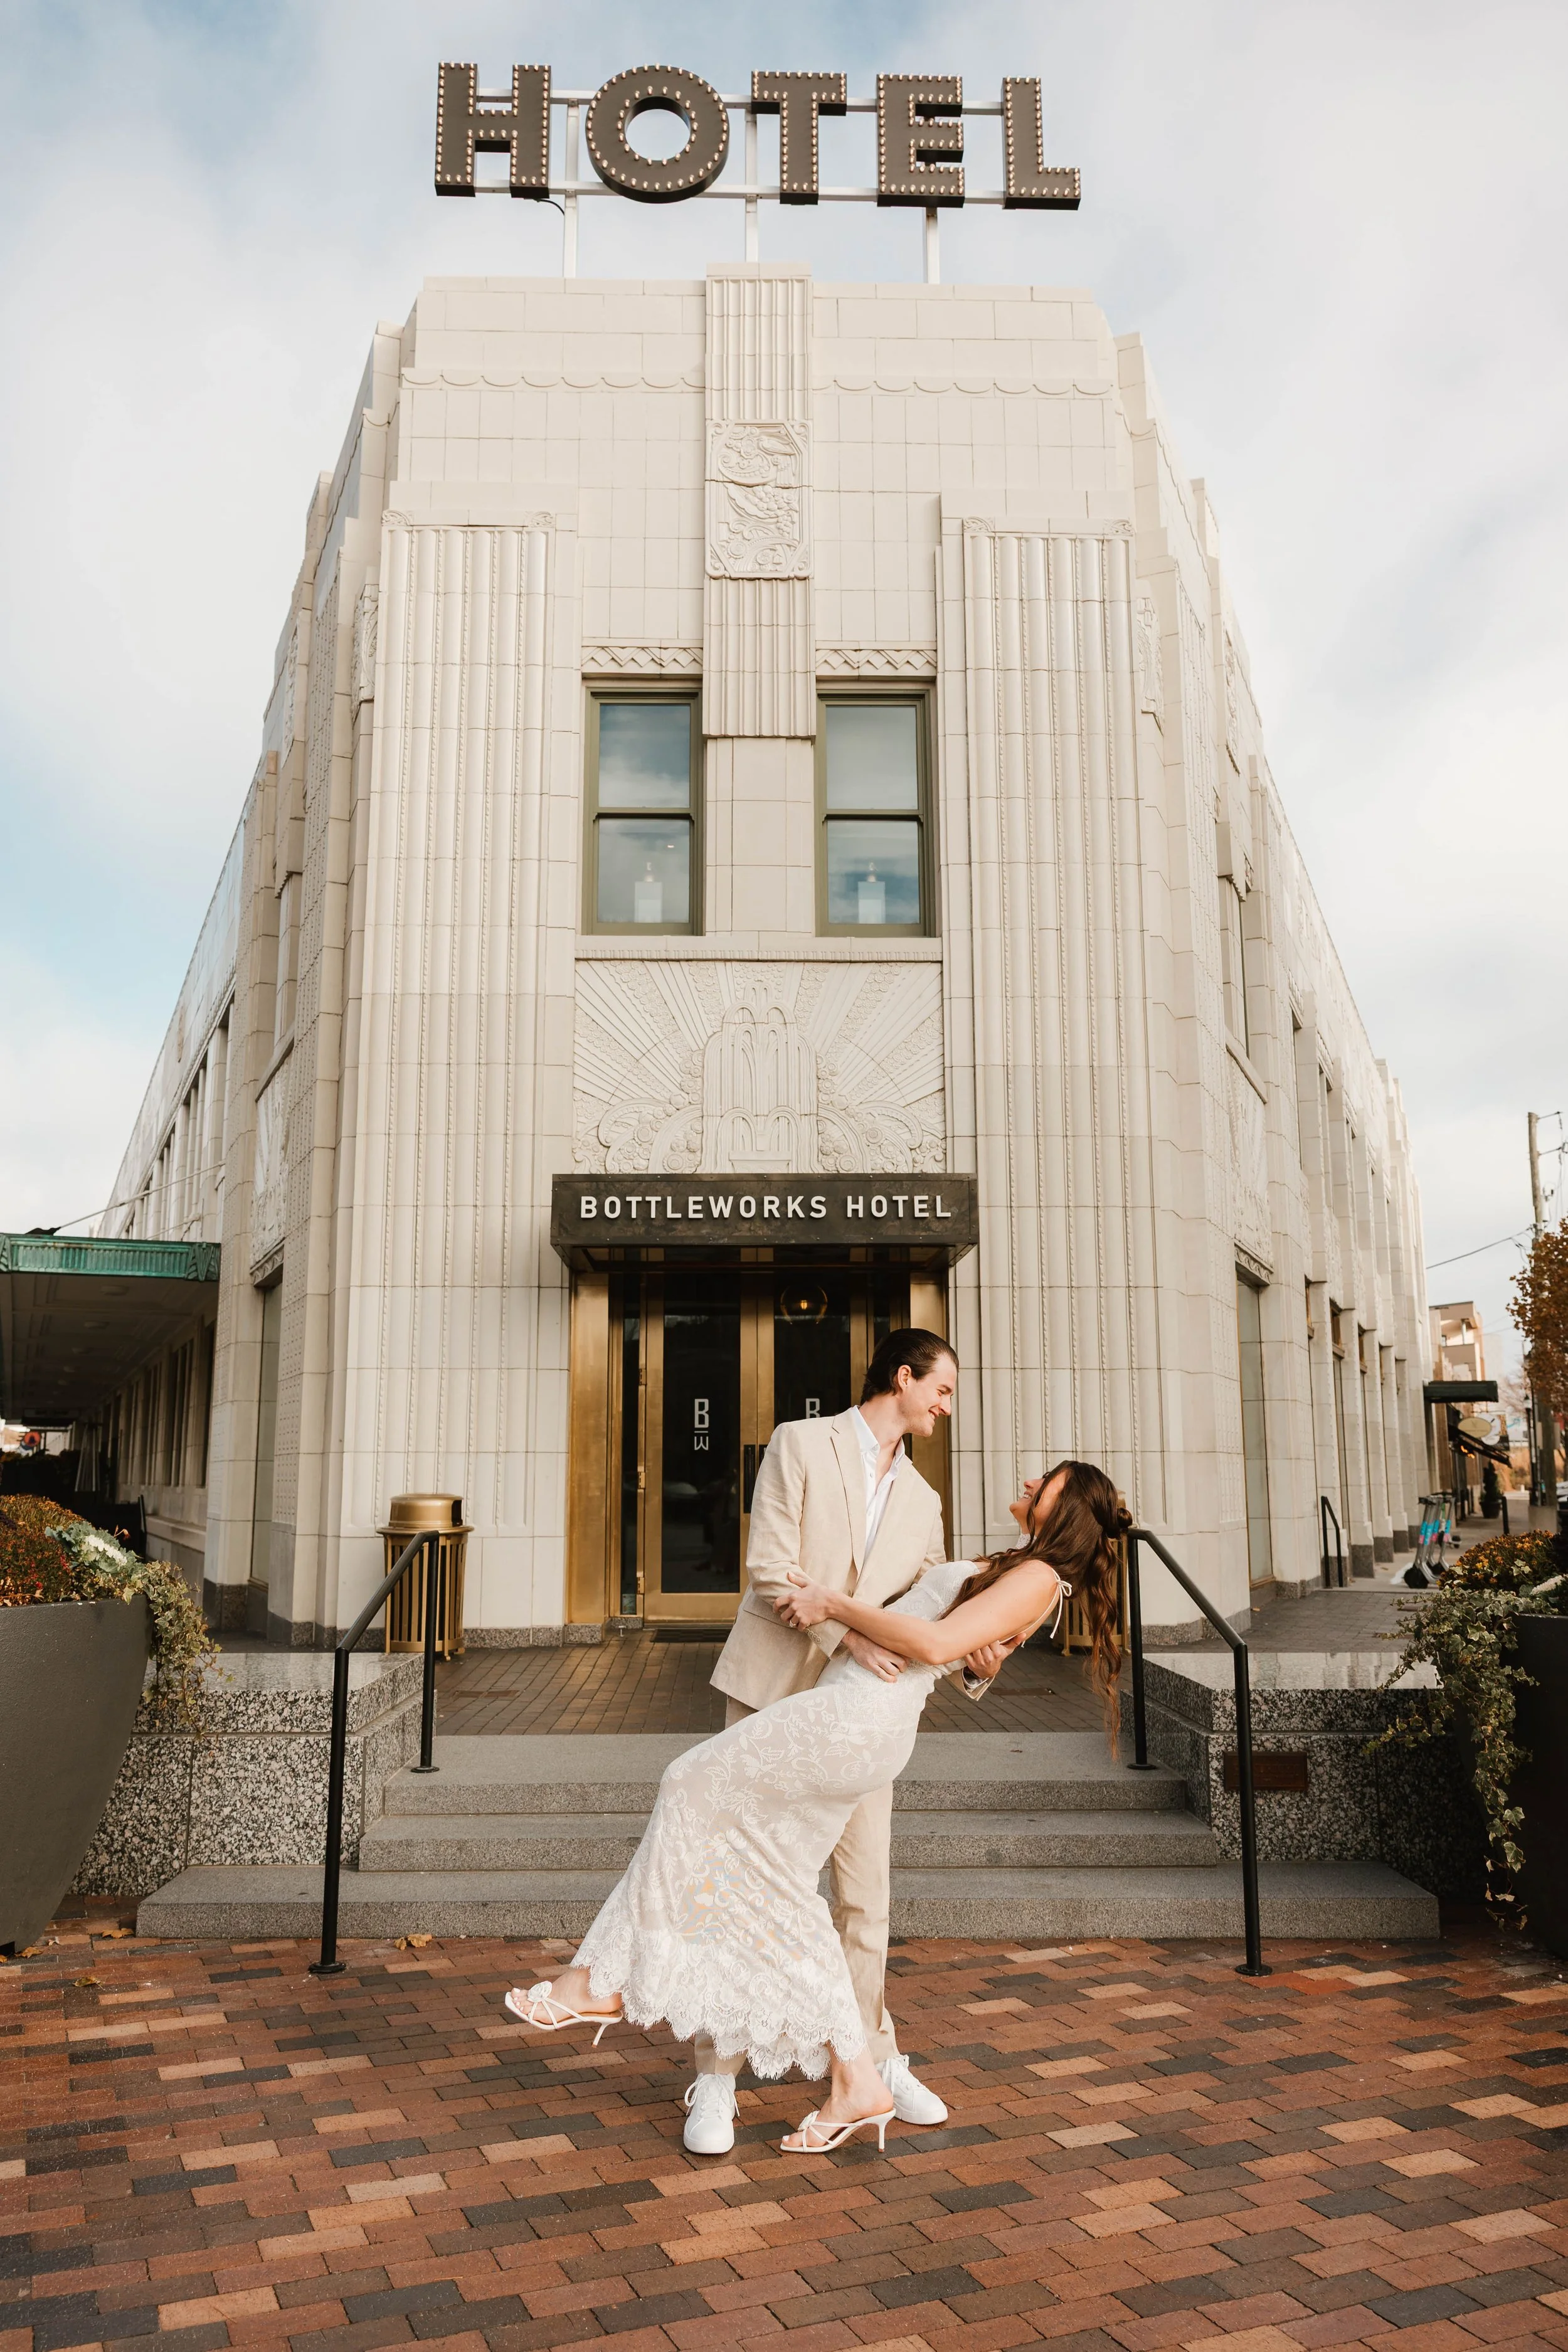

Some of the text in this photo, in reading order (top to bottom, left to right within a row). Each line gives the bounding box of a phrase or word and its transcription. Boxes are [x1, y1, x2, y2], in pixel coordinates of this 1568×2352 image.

[435, 61, 1082, 209] HOTEL
[580, 1194, 952, 1219] BOTTLEWORKS HOTEL
[694, 1398, 709, 1429] B
[694, 1436, 709, 1451] W
